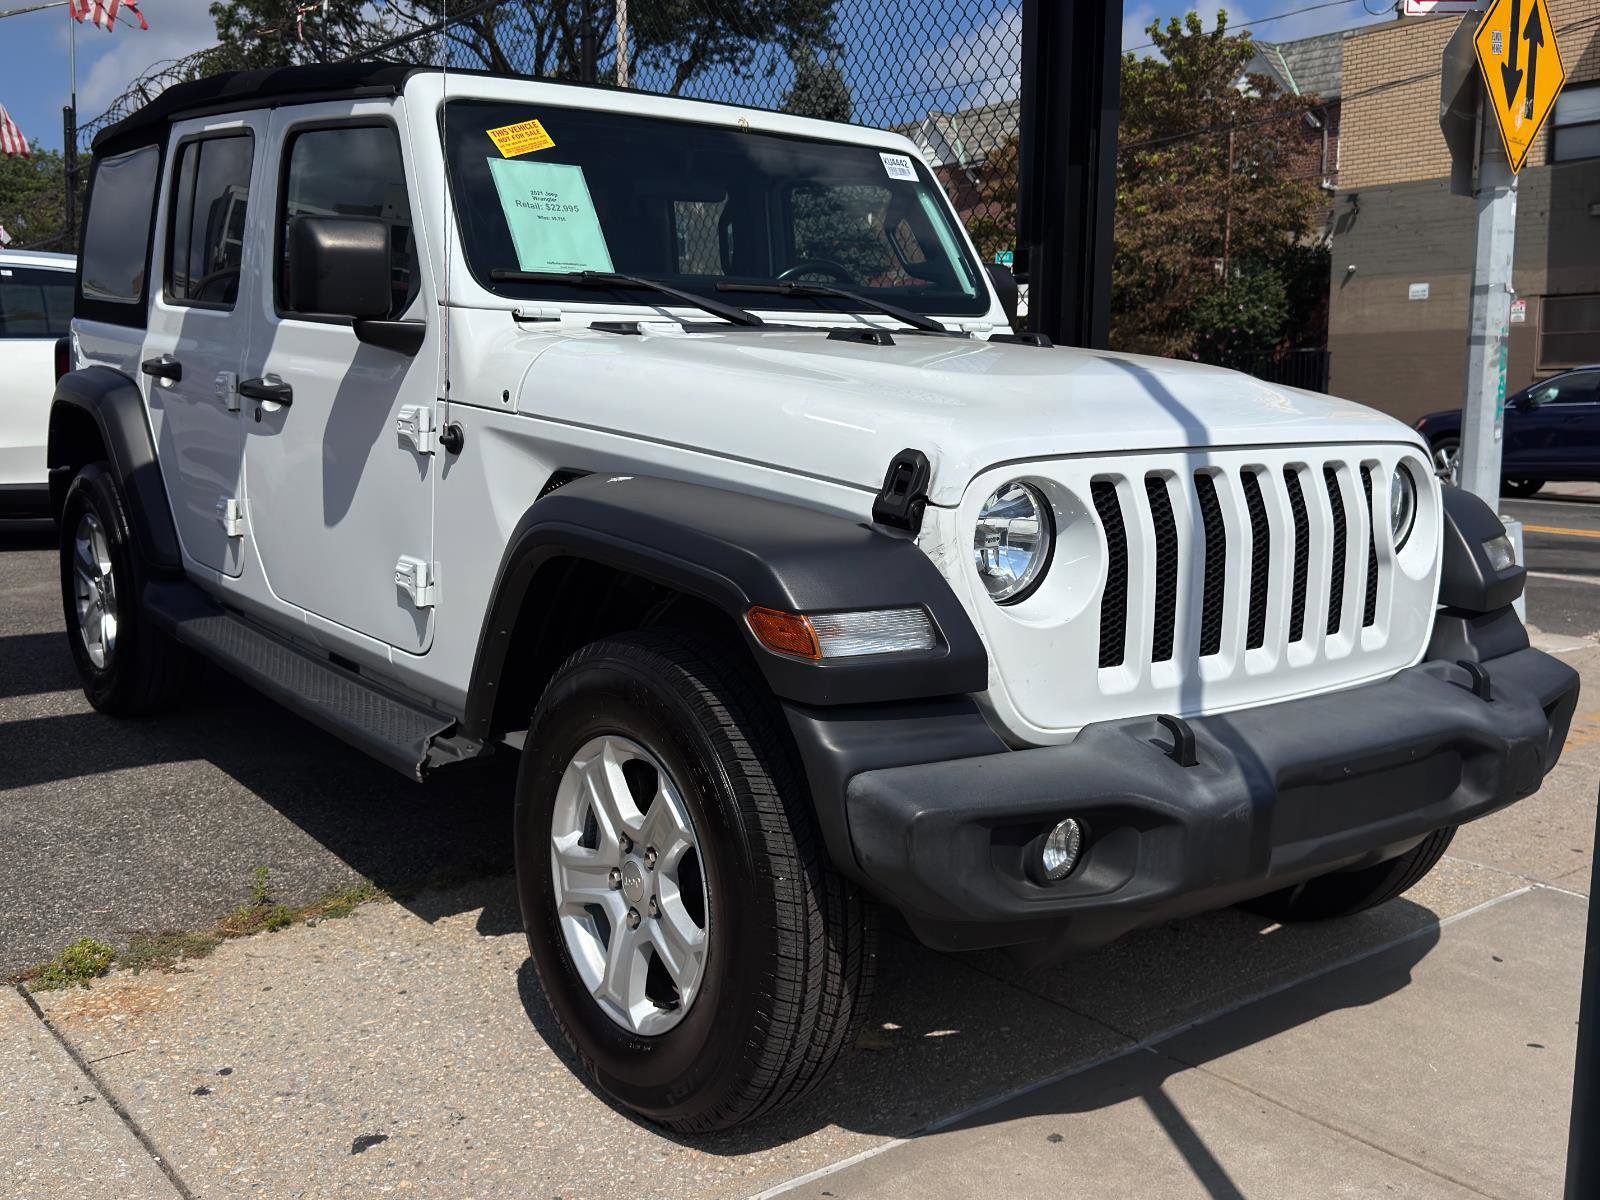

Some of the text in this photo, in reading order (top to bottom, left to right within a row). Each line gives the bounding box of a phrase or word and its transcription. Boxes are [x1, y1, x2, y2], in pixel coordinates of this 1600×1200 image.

[491, 121, 539, 138] THIS VEHICLE
[525, 129, 541, 137] SALE
[515, 199, 580, 213] Retail: $22,995
